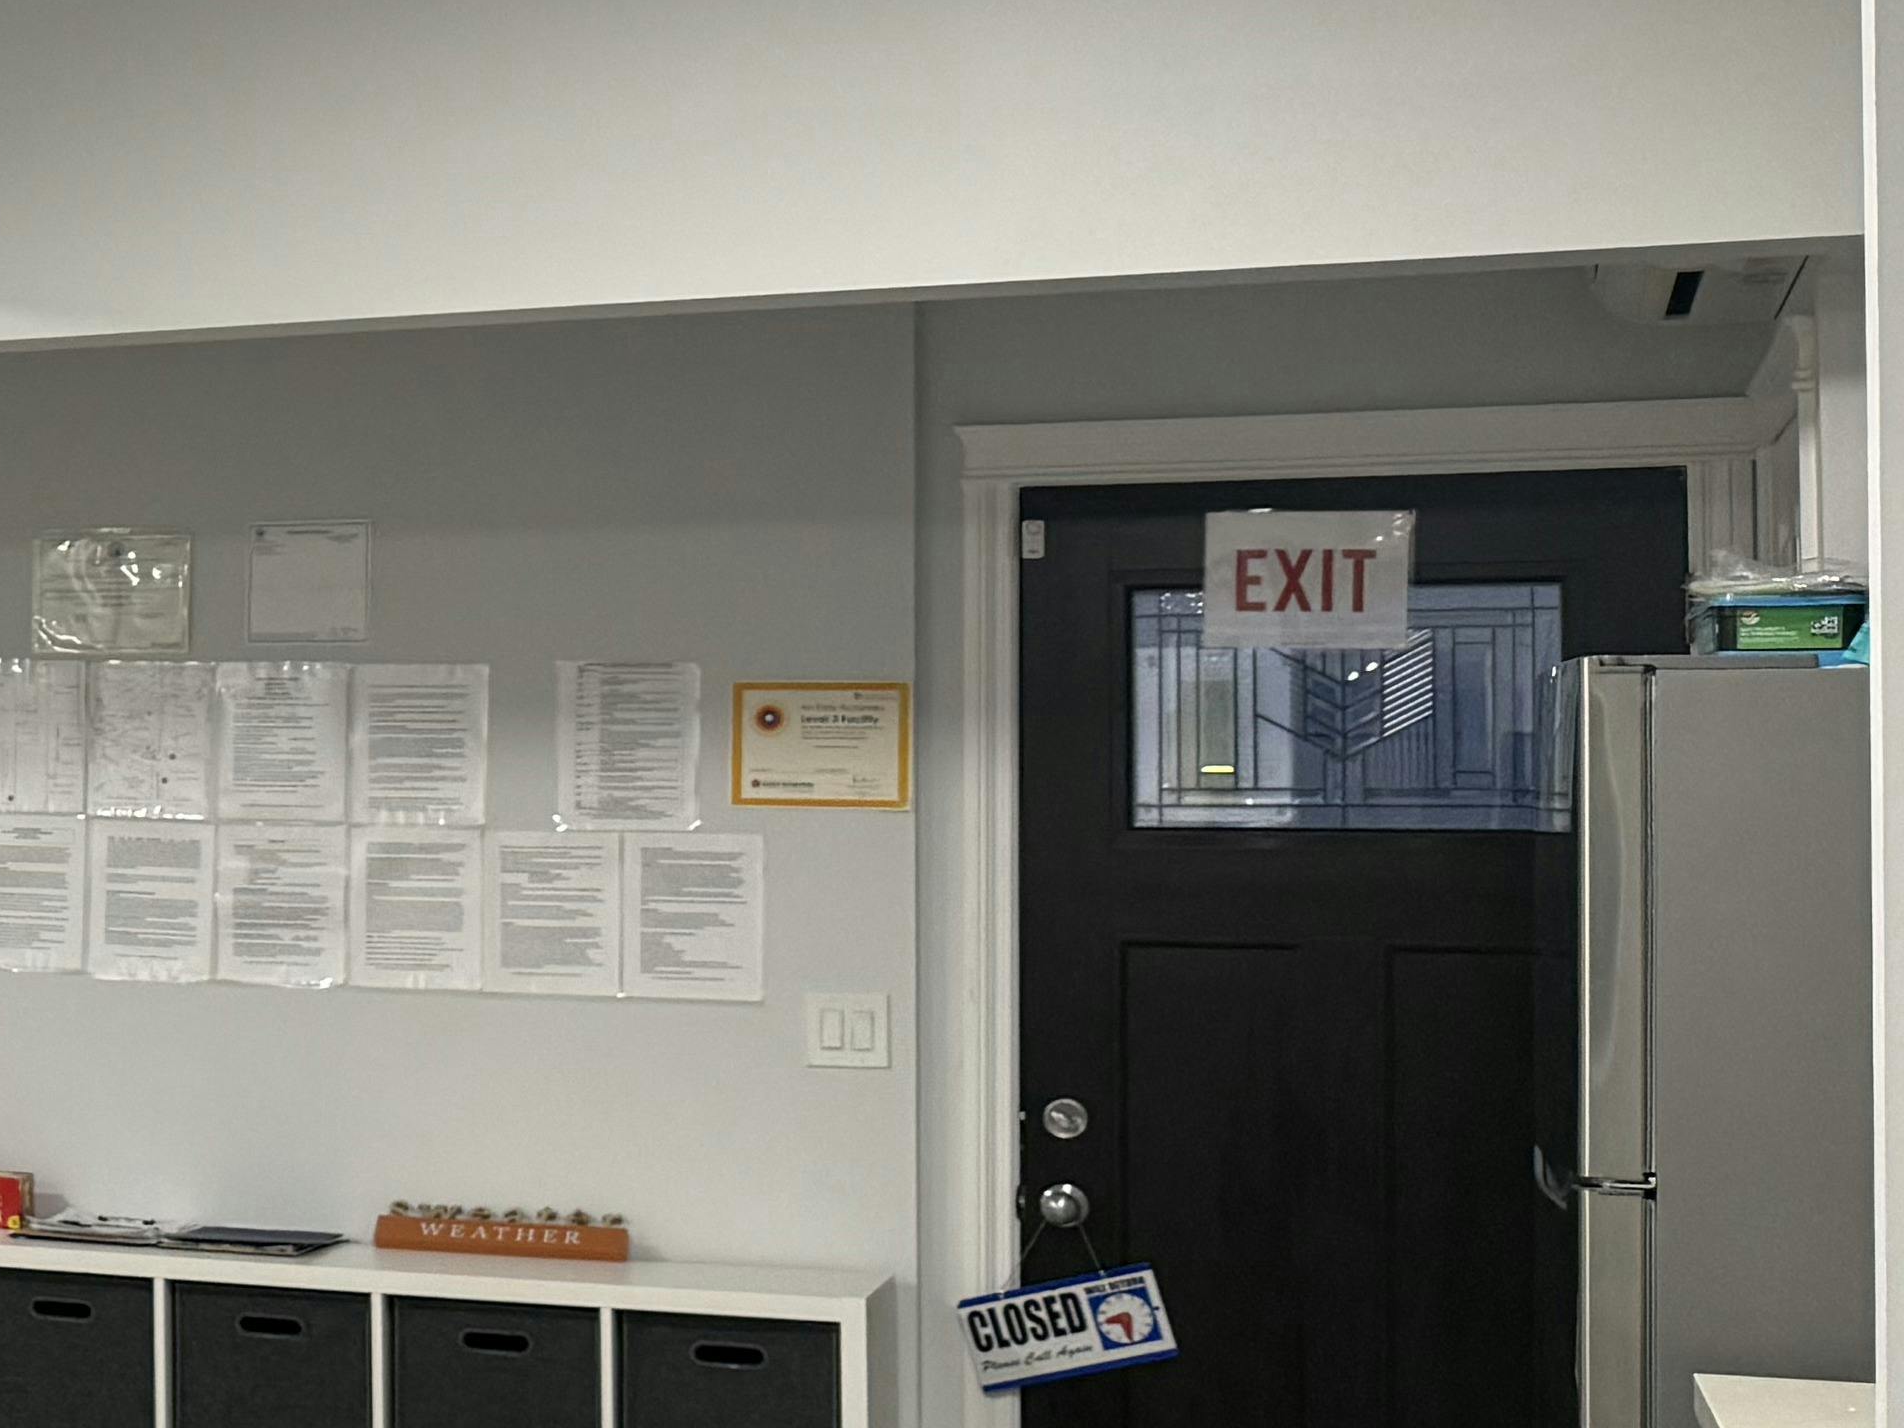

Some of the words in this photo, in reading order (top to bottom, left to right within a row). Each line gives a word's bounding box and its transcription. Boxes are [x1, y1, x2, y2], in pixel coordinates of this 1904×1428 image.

[1235, 548, 1377, 612] EXIT
[420, 1222, 581, 1245] WEATHER
[967, 1292, 1088, 1353] CLOSED
